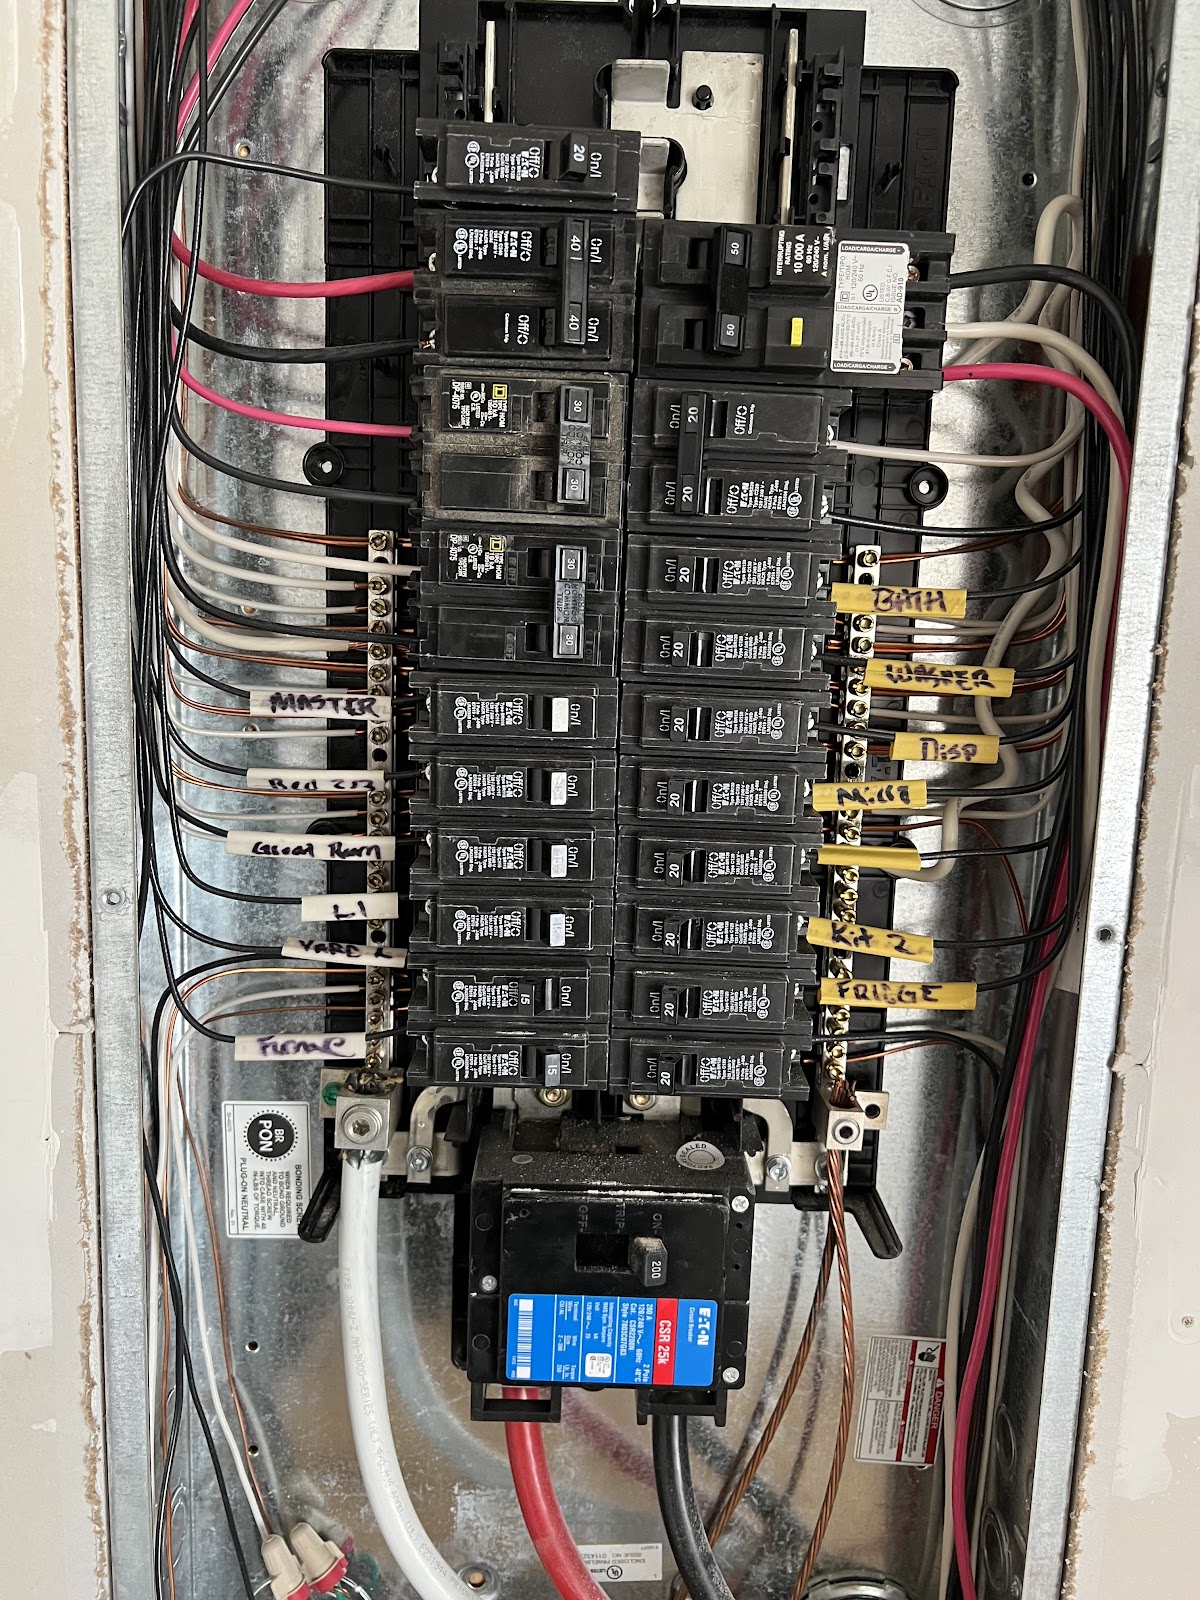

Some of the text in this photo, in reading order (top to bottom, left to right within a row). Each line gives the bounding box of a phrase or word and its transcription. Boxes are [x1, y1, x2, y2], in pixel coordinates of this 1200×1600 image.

[574, 144, 585, 161] 20
[571, 235, 581, 251] 40
[730, 242, 740, 256] 50
[776, 230, 785, 275] INTERRUPTING
[794, 234, 805, 273] 10 000 A
[806, 245, 813, 264] 60 Hz
[858, 264, 864, 282] 60 Hz
[569, 315, 579, 330] 40
[726, 324, 736, 337] 50
[452, 382, 460, 409] DP-4075
[574, 400, 582, 412] 30
[688, 407, 698, 423] 20
[571, 479, 578, 490] 30
[683, 486, 693, 502] 20
[568, 559, 575, 570] 30
[680, 567, 690, 583] 20
[566, 634, 573, 645] 30
[673, 642, 683, 657] 20
[270, 692, 380, 718] MASTER
[674, 717, 684, 732] 20
[670, 793, 680, 807] 20
[669, 864, 680, 878] 20
[665, 933, 675, 947] 20
[887, 934, 916, 955] 2
[521, 994, 530, 1004] 15
[836, 980, 943, 1005] FRIDGE
[664, 1003, 674, 1017] 20
[548, 1065, 558, 1075] 15
[661, 1072, 671, 1086] 20
[259, 1120, 273, 1152] PON
[275, 1128, 284, 1142] BR
[680, 1143, 707, 1158] SEALED
[240, 1158, 248, 1192] PLUG-ON
[279, 1171, 284, 1179] TO
[295, 1165, 303, 1200] BONDING
[254, 1193, 259, 1201] OF
[651, 1261, 661, 1279] 200
[621, 1303, 629, 1318] Style
[629, 1303, 637, 1314] Cat.
[657, 1320, 672, 1364] CSR 25k
[931, 1391, 942, 1429] DANGER
